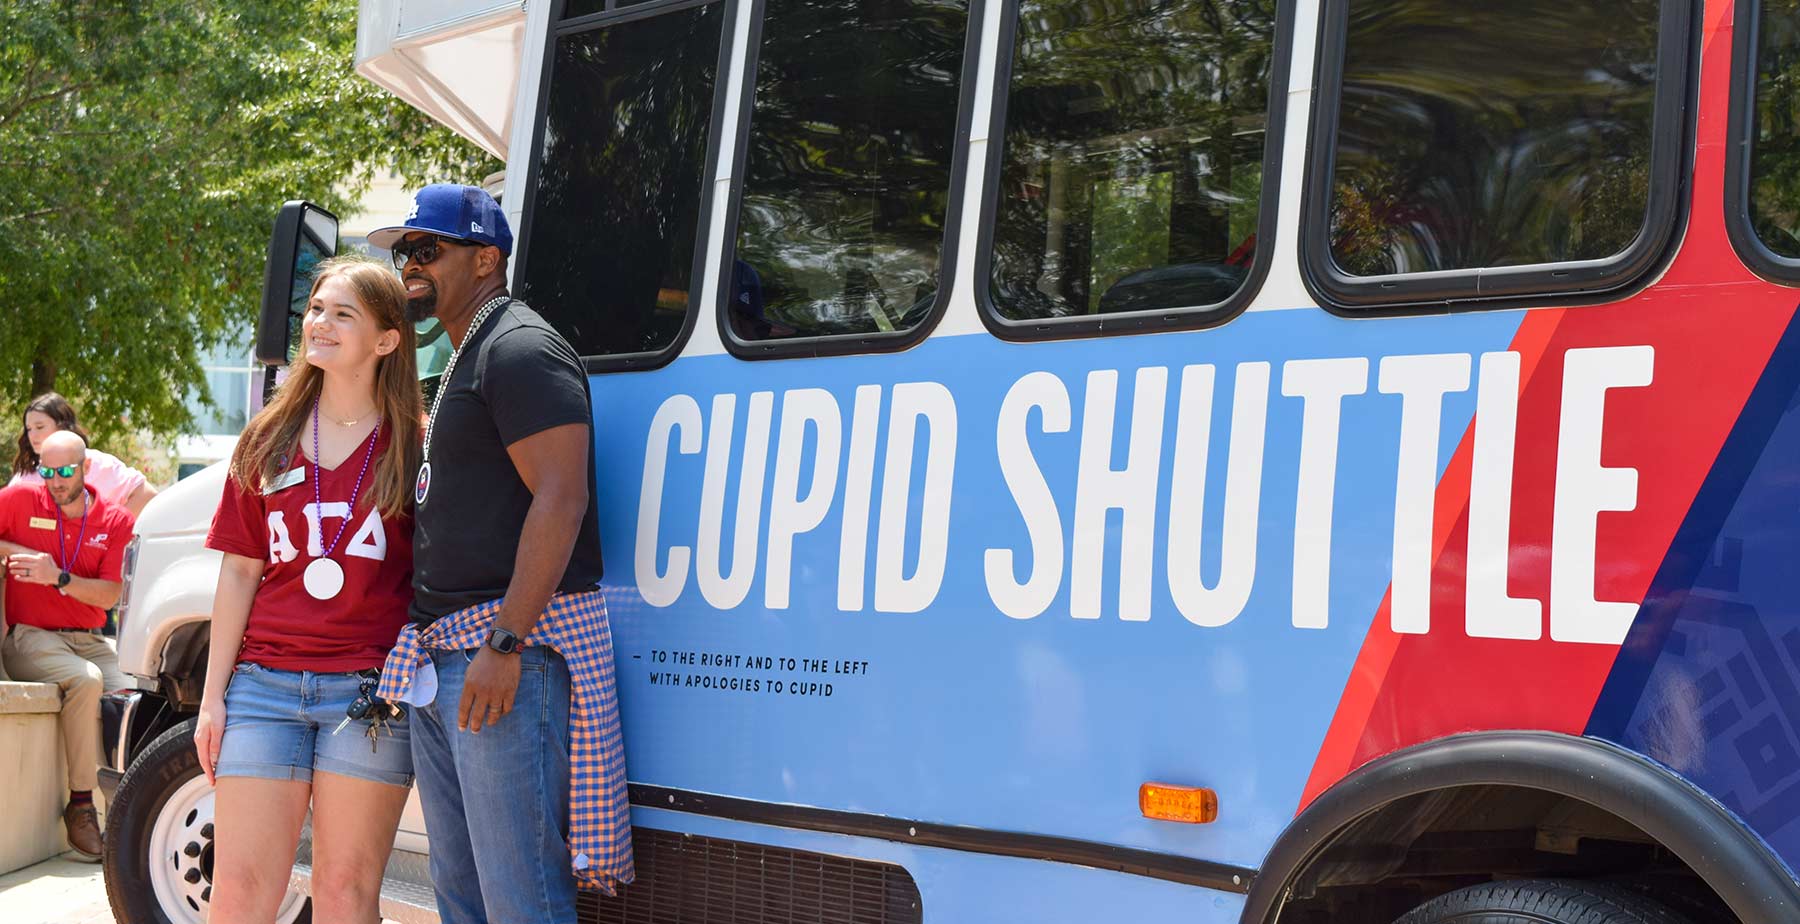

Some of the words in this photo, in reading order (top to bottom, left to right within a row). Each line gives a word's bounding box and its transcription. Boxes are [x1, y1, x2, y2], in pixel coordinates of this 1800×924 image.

[634, 381, 958, 613] CUPID
[984, 345, 1655, 645] SHUTTLE
[652, 650, 667, 663] TO
[672, 651, 695, 665] THE
[701, 653, 741, 668] RIGHT
[746, 655, 773, 670] AND
[779, 657, 796, 671] TO
[802, 659, 828, 673] THE
[835, 660, 869, 675] LEFT
[649, 671, 680, 686] WITH
[685, 675, 760, 692] APOLOGIES
[766, 680, 783, 693] TO
[790, 681, 833, 697] CUPID
